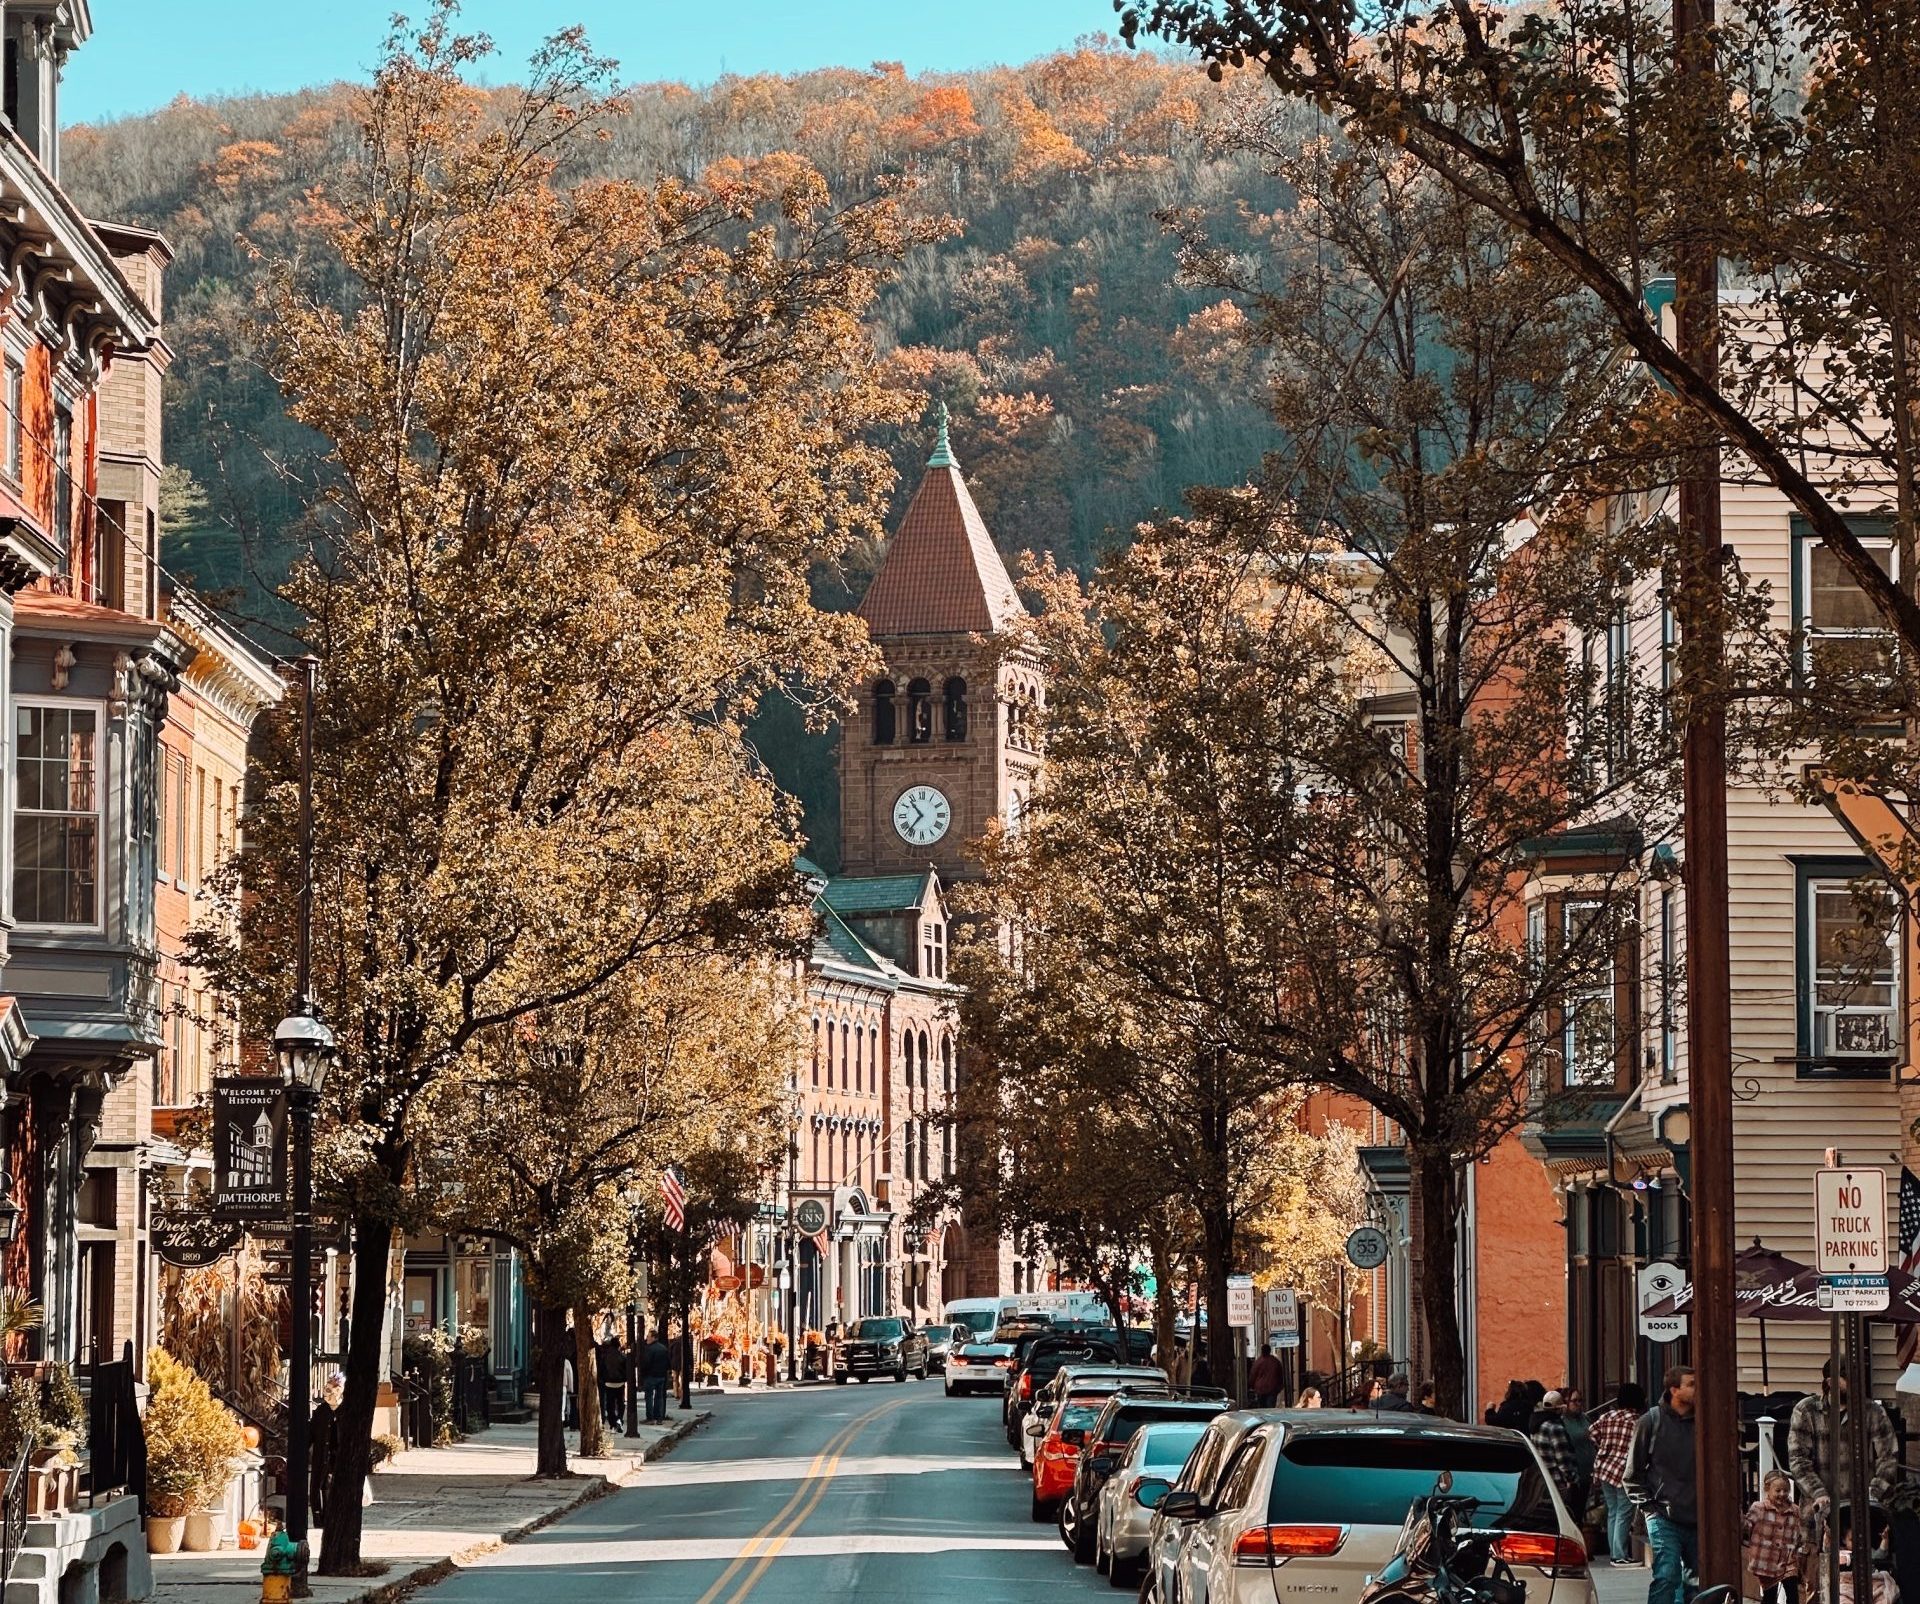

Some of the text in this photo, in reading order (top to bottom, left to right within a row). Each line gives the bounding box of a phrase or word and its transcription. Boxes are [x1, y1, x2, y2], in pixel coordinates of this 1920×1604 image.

[219, 1088, 282, 1096] WELCOME TO
[228, 1096, 273, 1105] HISTORIC
[217, 1192, 282, 1206] JIM THORPE
[1838, 1187, 1862, 1209] NO
[1831, 1217, 1871, 1233] TRUCK
[1357, 1238, 1378, 1254] 55
[1825, 1240, 1878, 1257] PARKING
[1235, 1292, 1246, 1300] NO
[1275, 1293, 1288, 1303] NO
[1231, 1303, 1249, 1311] TRUCK
[1271, 1306, 1293, 1315] TRUCK
[1270, 1318, 1296, 1327] PARKING
[1647, 1322, 1679, 1330] BOOKS
